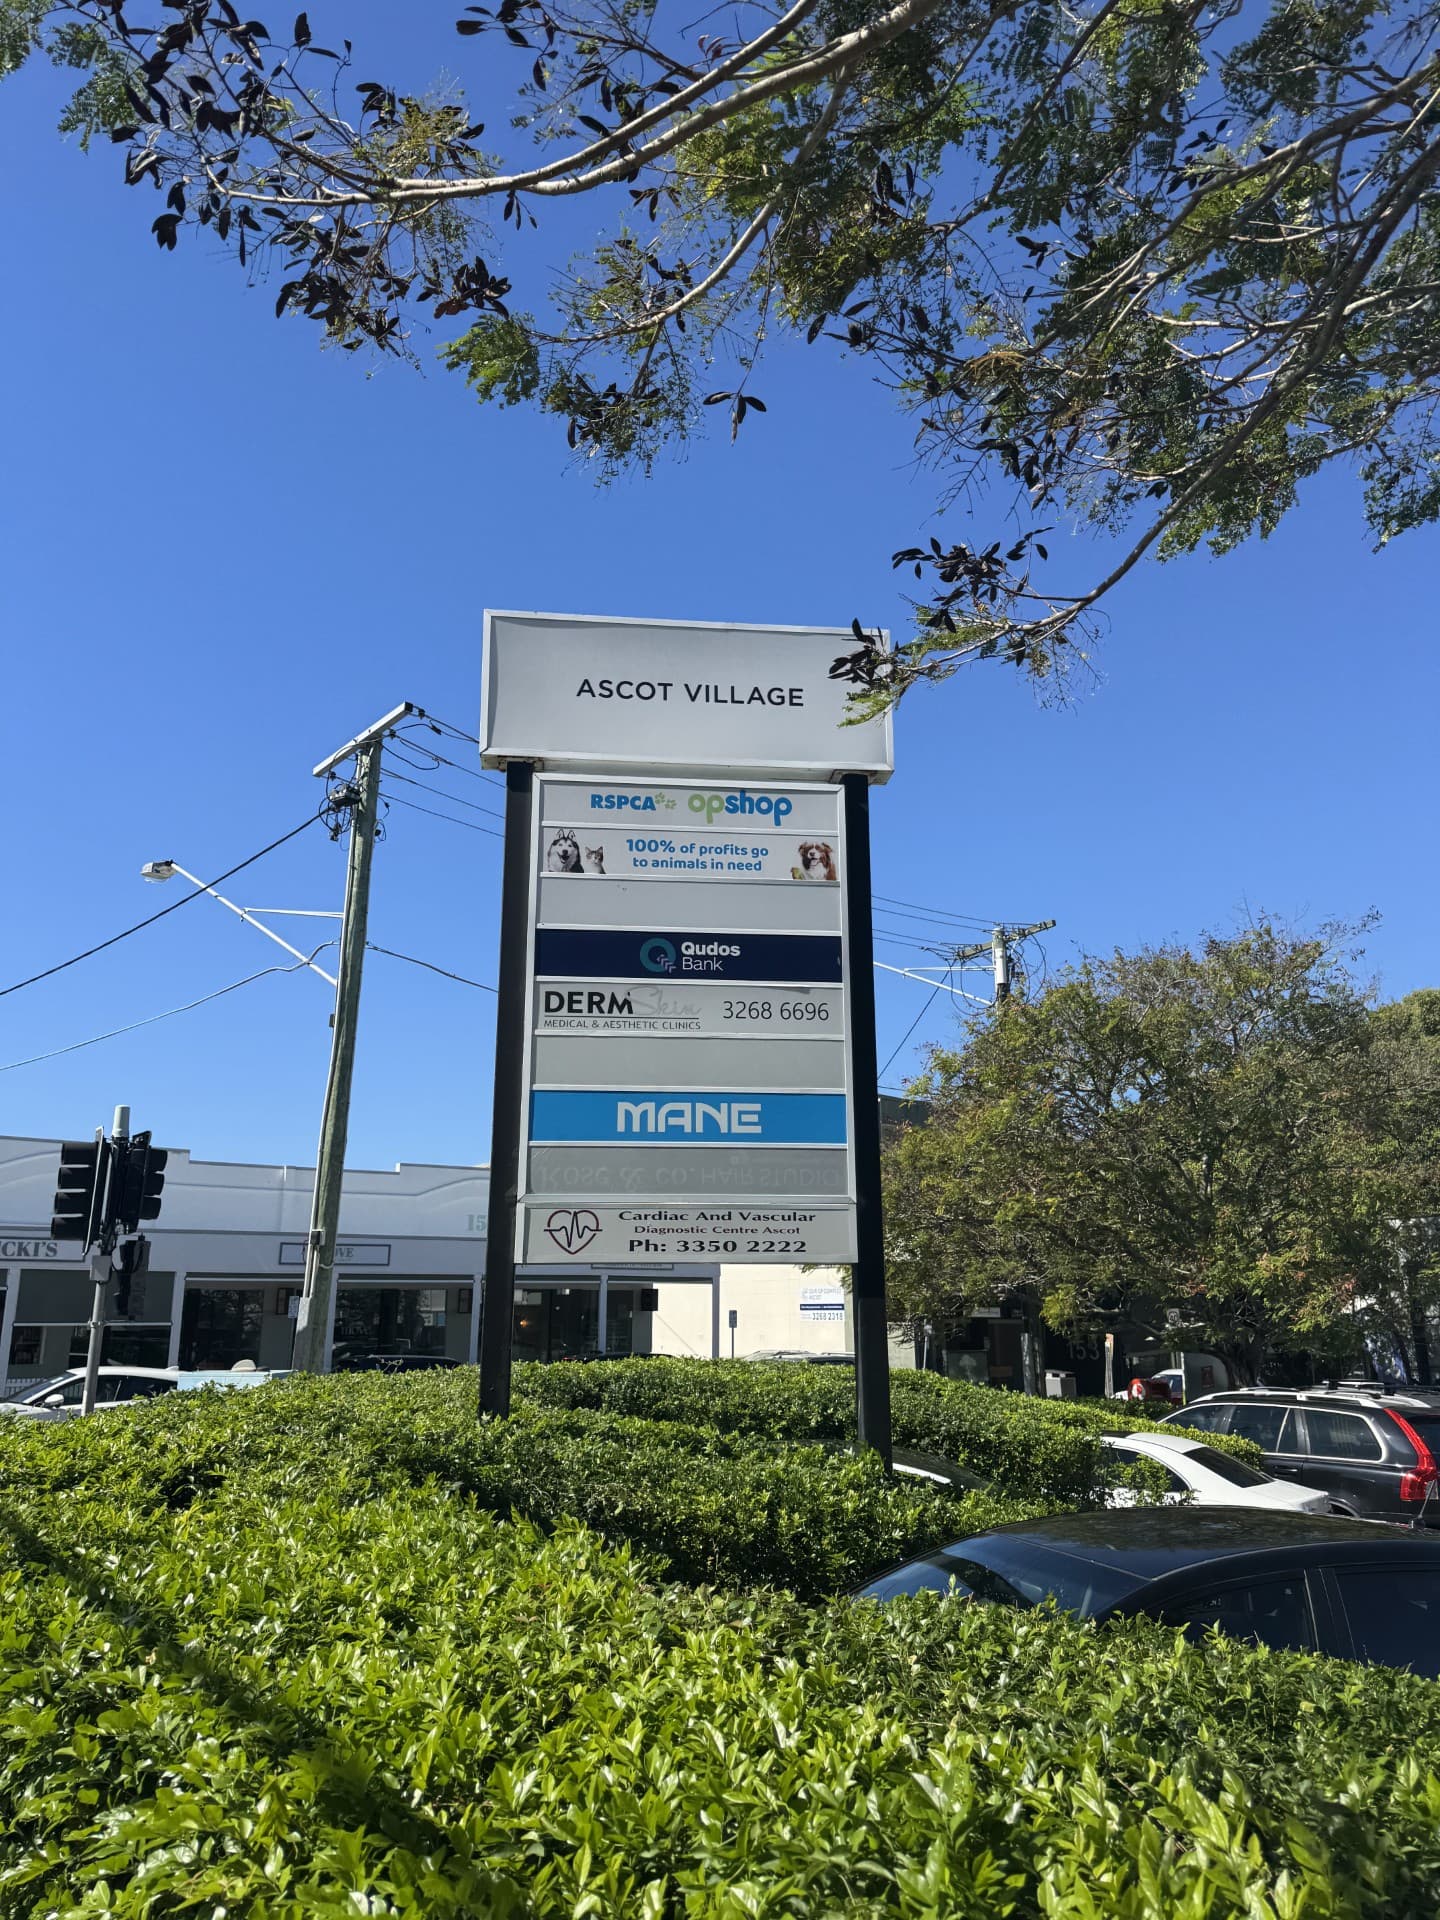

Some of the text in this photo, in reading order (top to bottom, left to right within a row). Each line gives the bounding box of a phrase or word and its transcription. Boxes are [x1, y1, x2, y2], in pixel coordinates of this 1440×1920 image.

[576, 678, 804, 707] ASCOT VILLAGE
[590, 789, 793, 827] RSPCA opshop
[626, 838, 769, 860] 100% of profits go
[632, 857, 762, 871] to animals in need
[681, 941, 741, 957] Qudos
[682, 957, 724, 971] Bank
[544, 990, 634, 1015] DERM
[722, 1000, 830, 1021] 3268 6696
[543, 1019, 702, 1031] MEDICAL & AESTHETIC CLINICS
[616, 1101, 762, 1134] MANE
[618, 1210, 816, 1223] Cardiac And Vascular
[634, 1226, 800, 1236] Diagnostic Centre Ascot
[0, 1240, 58, 1258] CKI'S
[629, 1239, 807, 1253] Ph: 3350 2222
